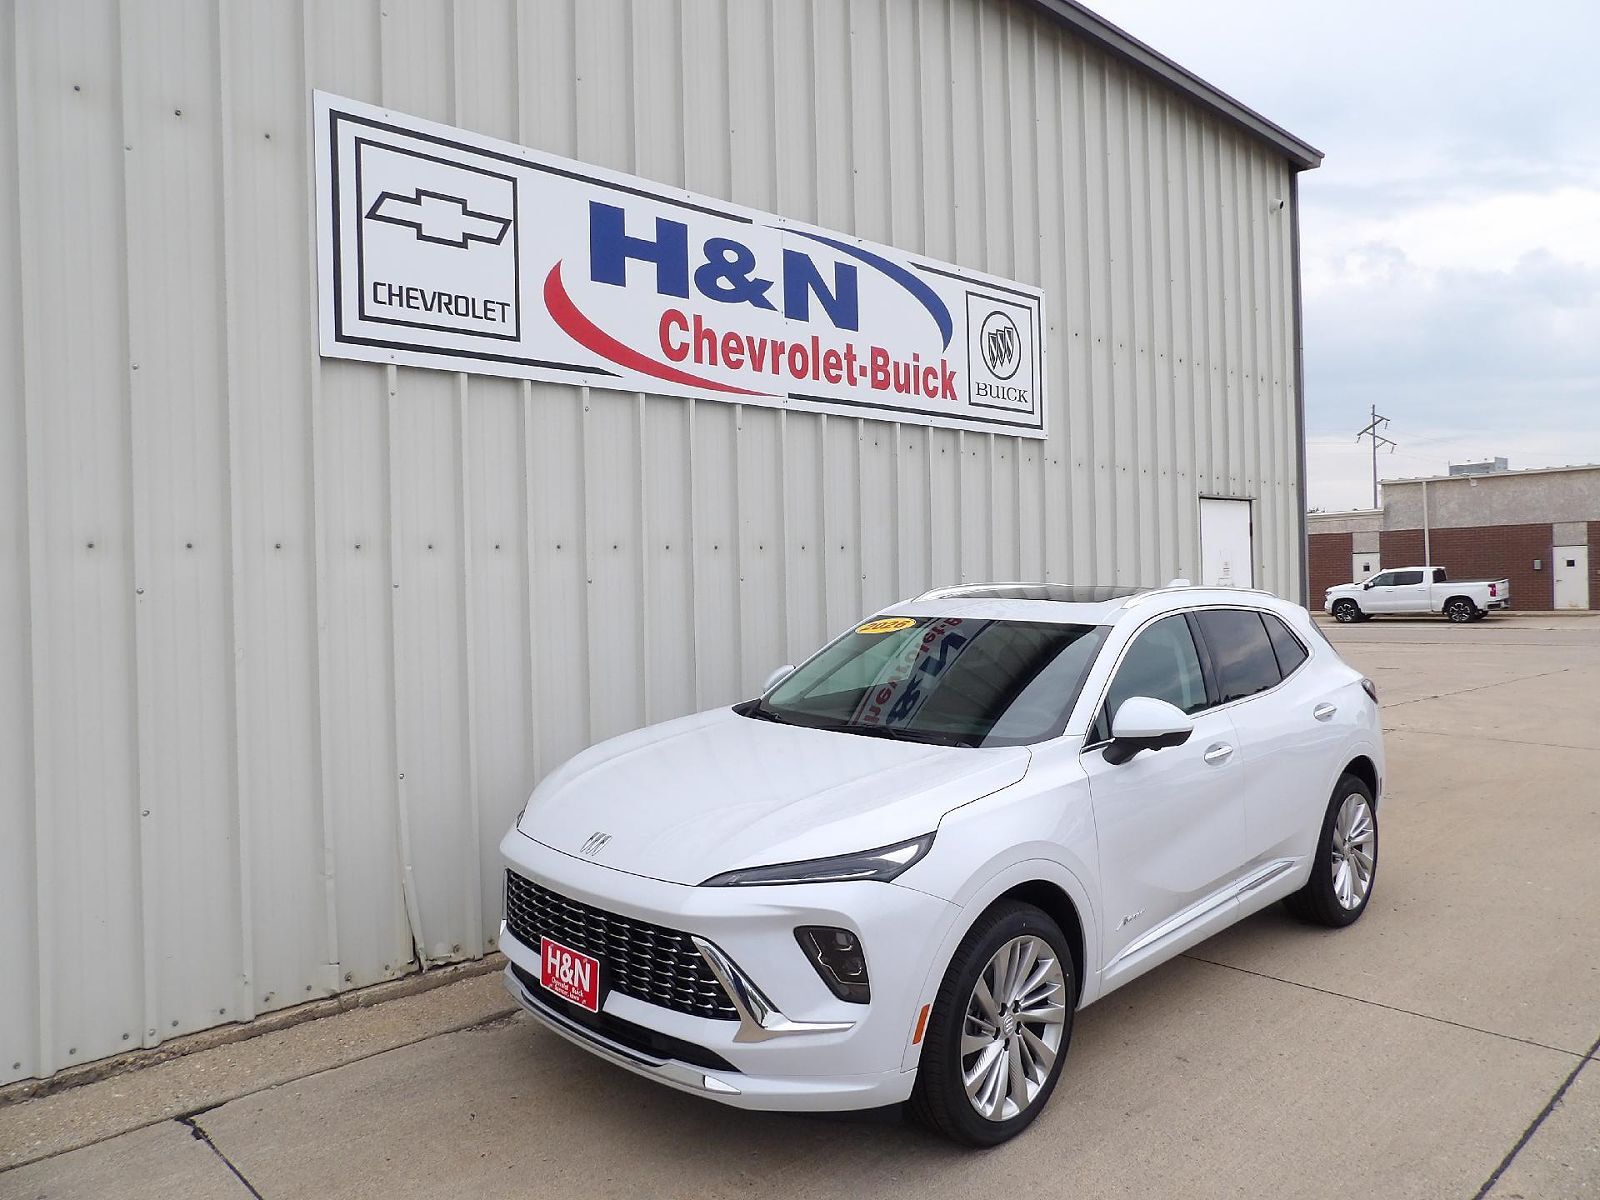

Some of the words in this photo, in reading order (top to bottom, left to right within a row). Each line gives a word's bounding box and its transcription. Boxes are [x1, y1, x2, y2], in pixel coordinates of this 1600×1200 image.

[589, 200, 859, 331] H&N
[372, 281, 511, 323] CHEVROLET
[658, 309, 958, 401] Chevrolet-Buick
[976, 382, 1028, 403] BUICK
[547, 945, 591, 992] H&N
